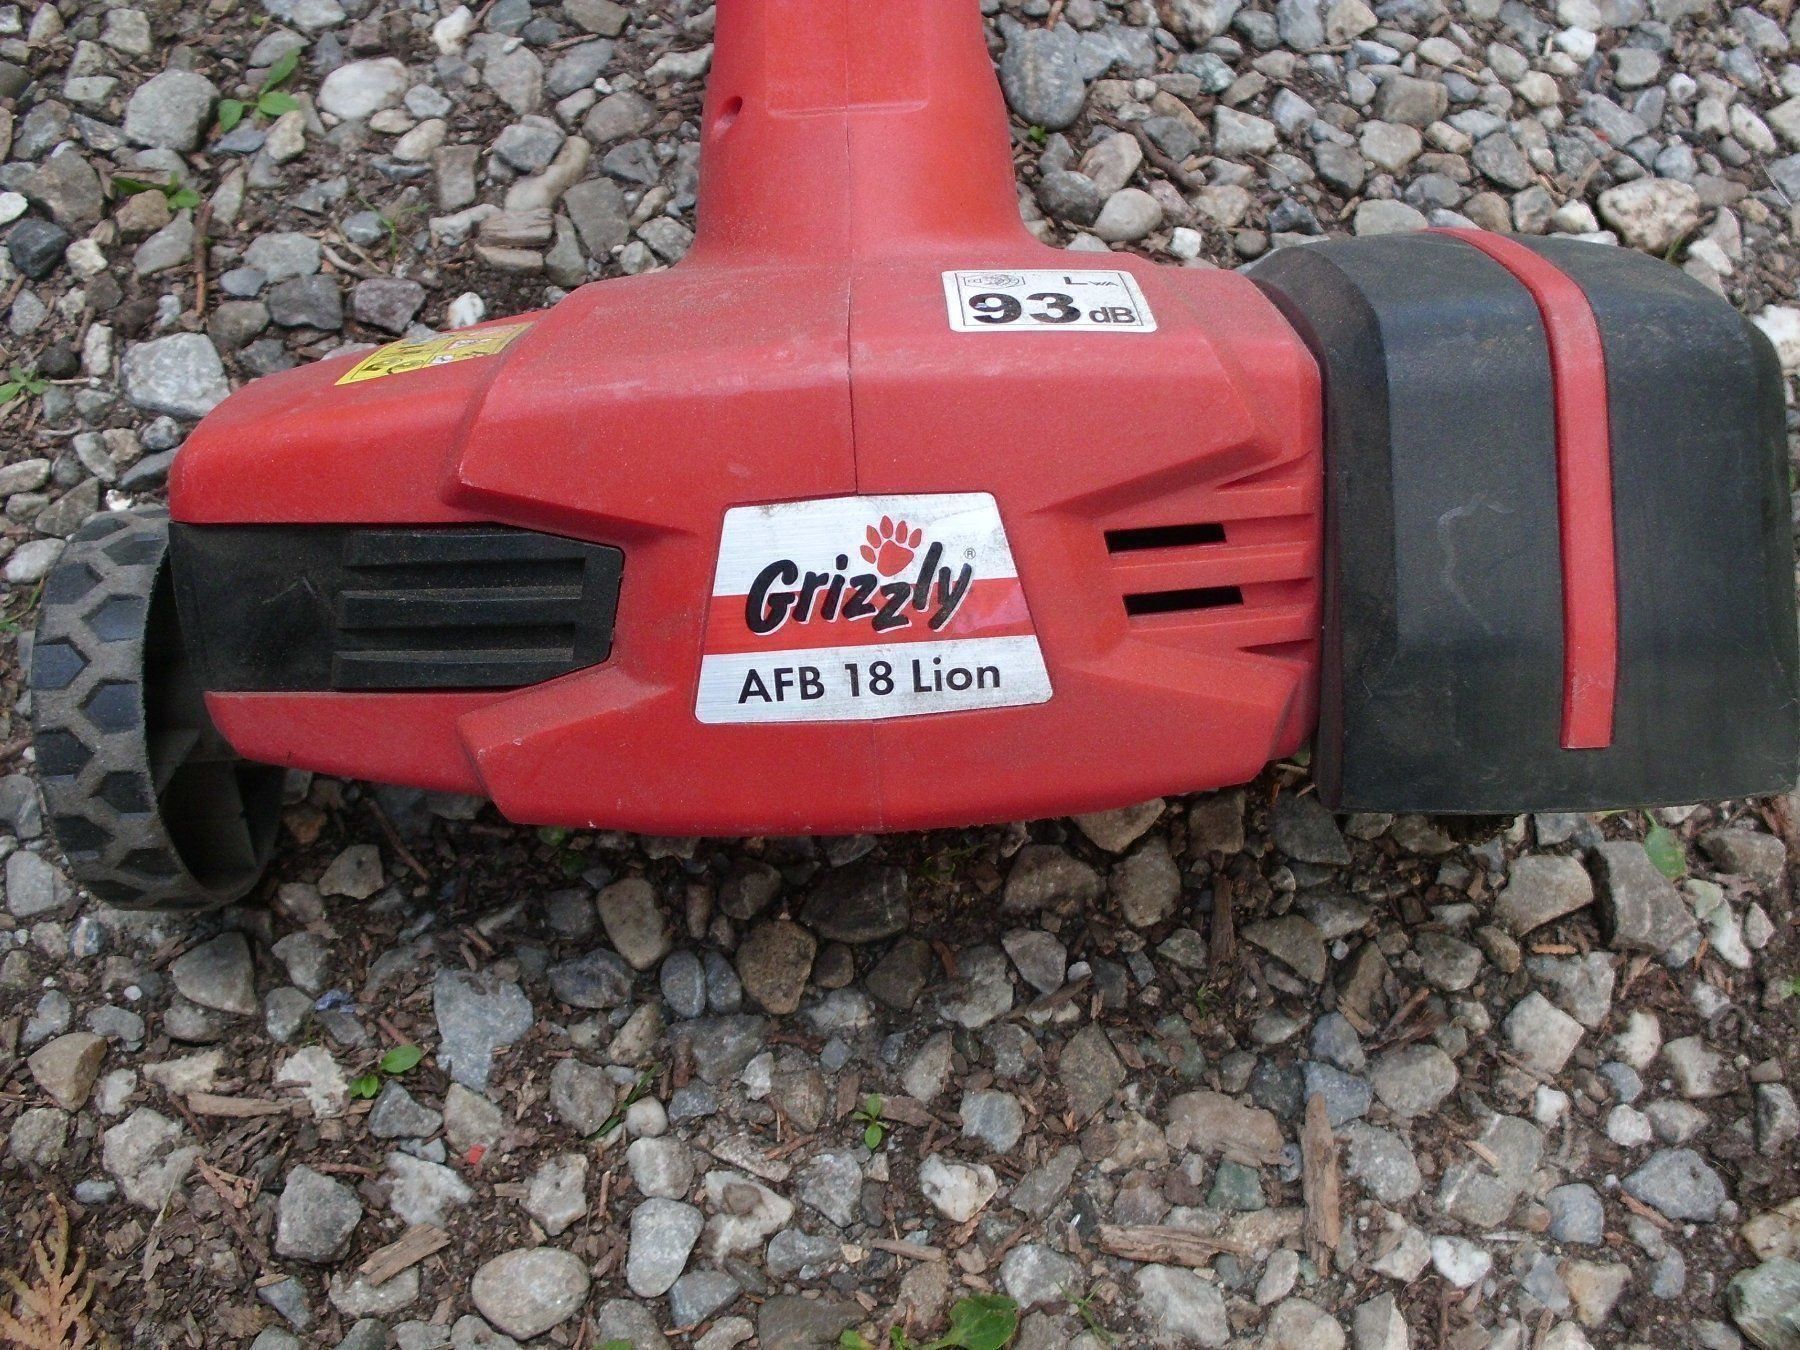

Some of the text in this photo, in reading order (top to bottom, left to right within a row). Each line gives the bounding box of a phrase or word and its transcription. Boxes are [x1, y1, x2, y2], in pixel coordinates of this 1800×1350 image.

[968, 292, 1136, 324] 93 dB
[745, 541, 973, 634] Grizzly
[738, 656, 1001, 704] AFB 18 Lion
